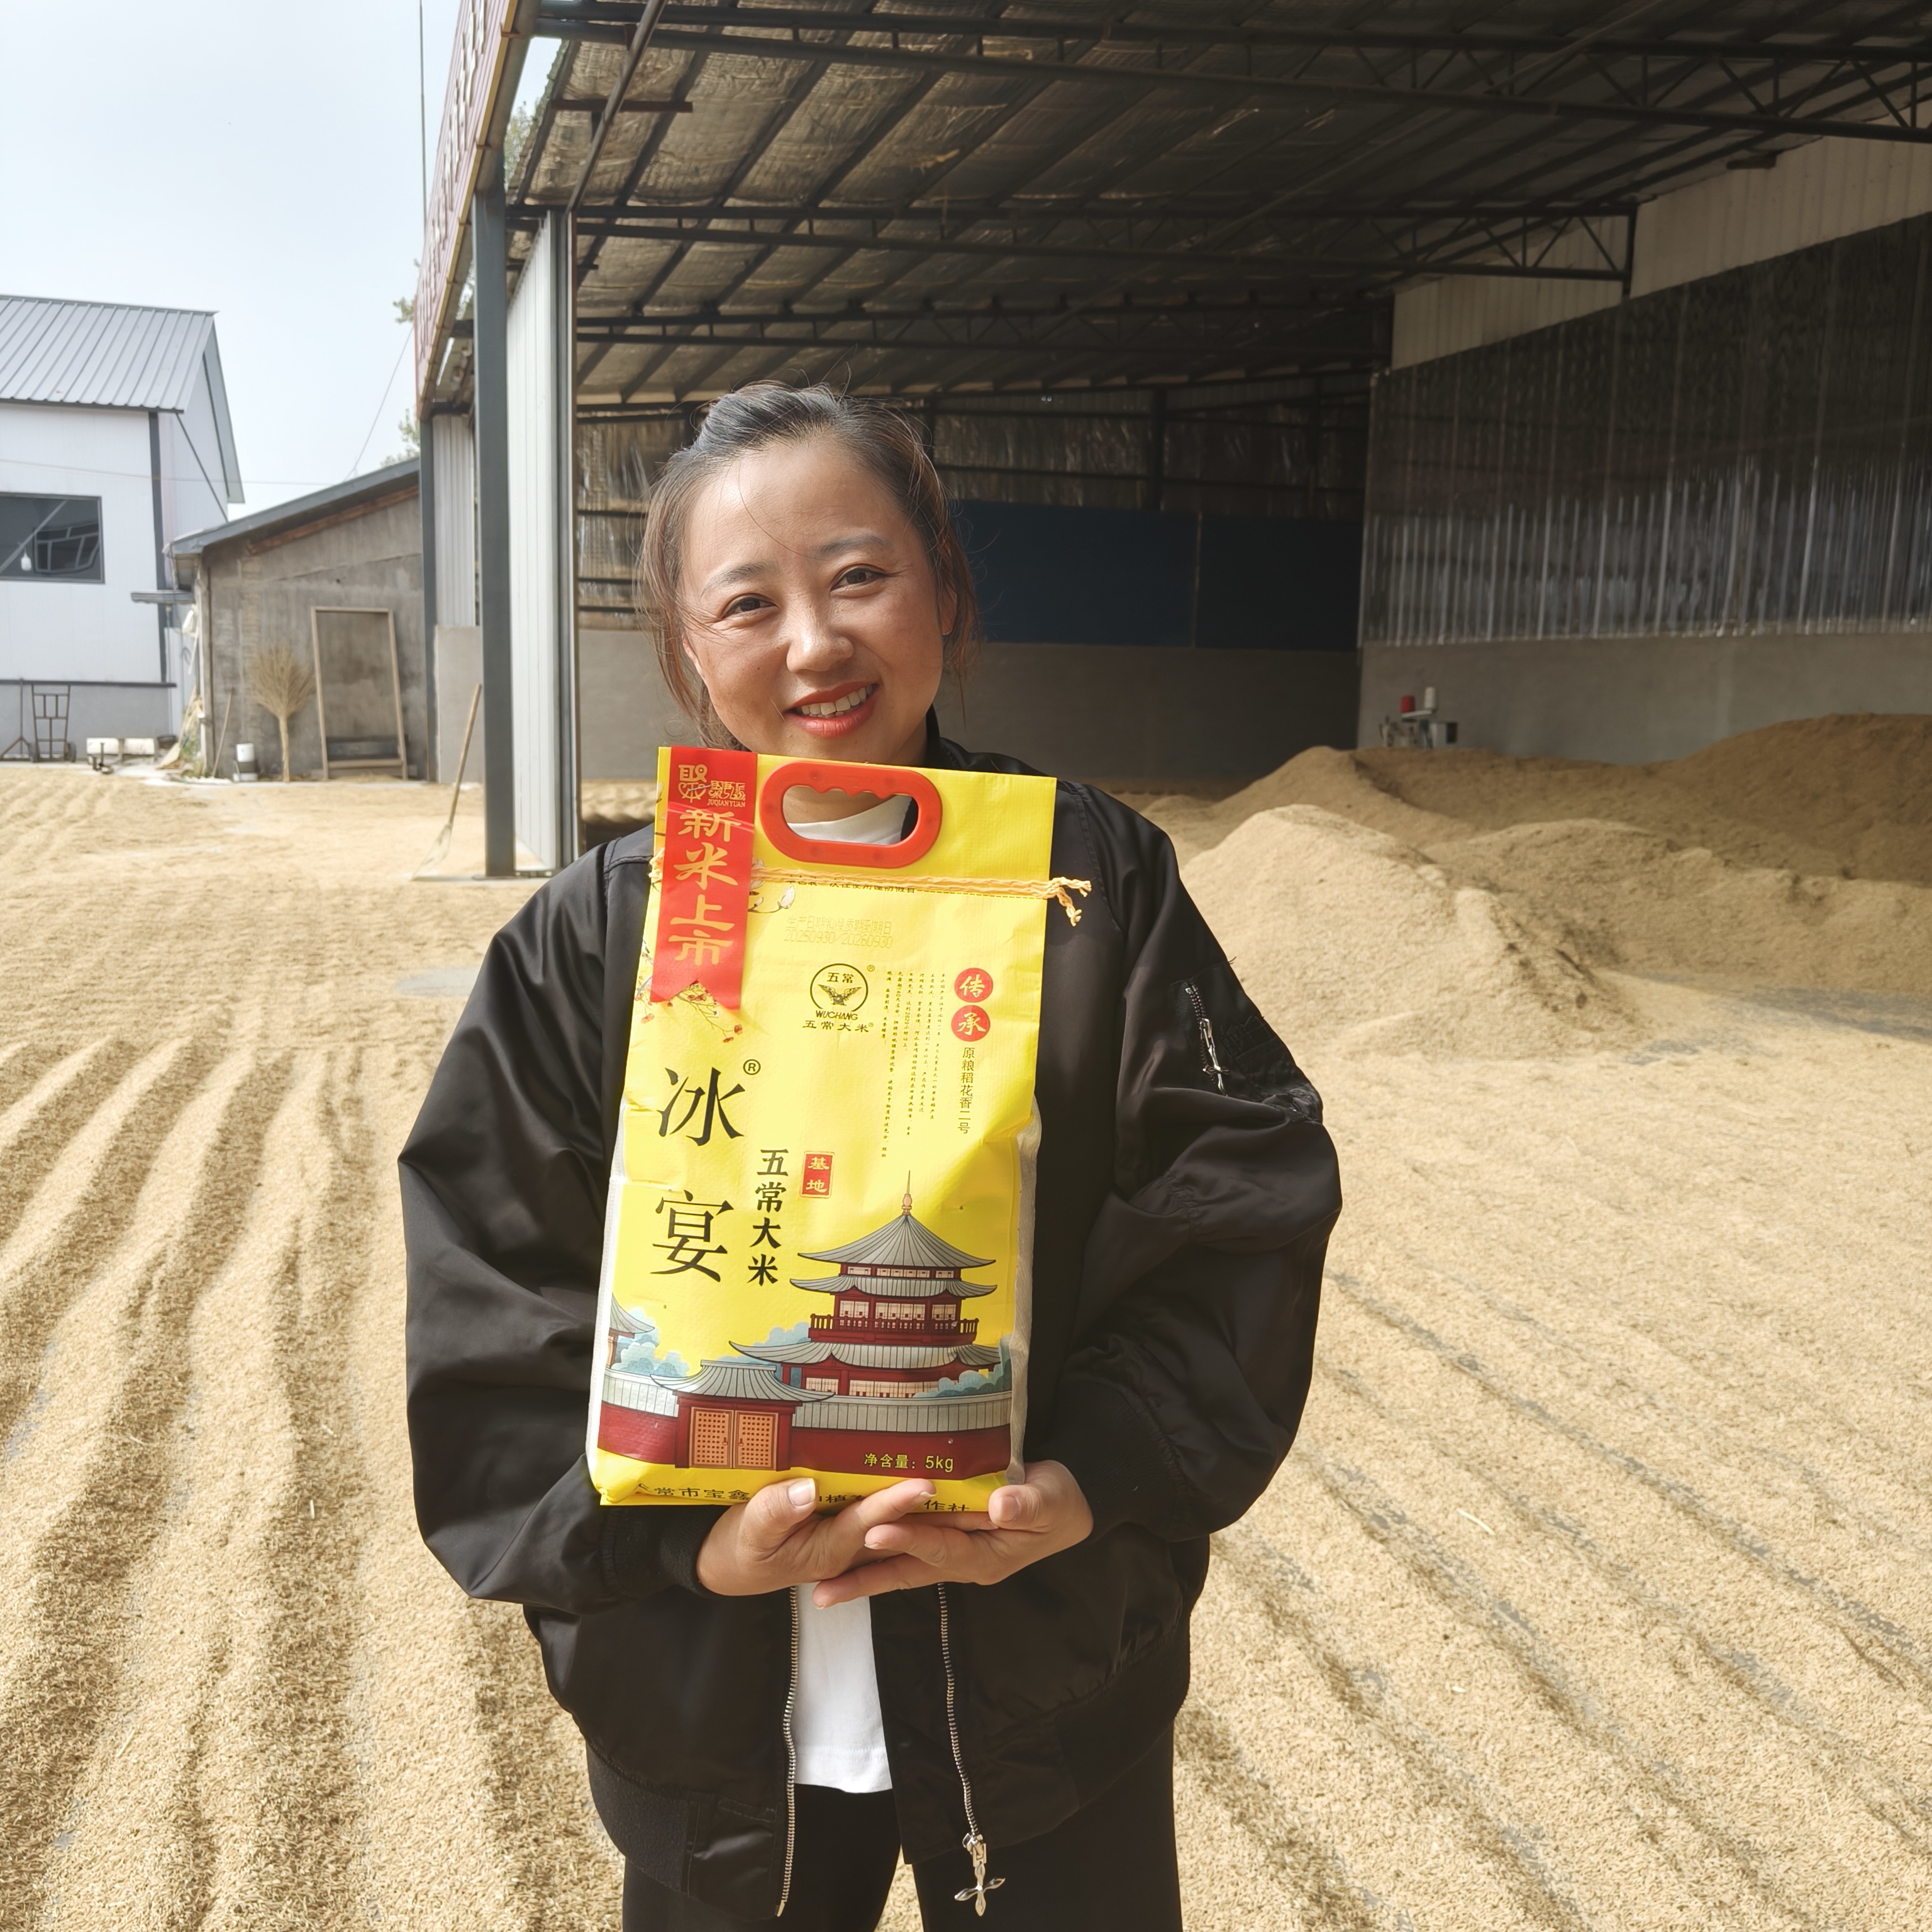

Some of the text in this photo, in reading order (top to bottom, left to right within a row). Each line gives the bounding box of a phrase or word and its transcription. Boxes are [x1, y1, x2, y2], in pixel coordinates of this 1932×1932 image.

[707, 799, 746, 808] JUQIANYUAN
[668, 809, 741, 967] 新米上市
[826, 972, 854, 984] 五常
[802, 1020, 869, 1033] 五常大米
[816, 1010, 858, 1021] WUCHANG
[958, 974, 986, 1036] 传承
[958, 1047, 975, 1135] 原粮稻花香二号
[650, 1067, 746, 1283] 冰宴
[805, 1157, 830, 1193] 基地
[747, 1148, 789, 1286] 五常大米
